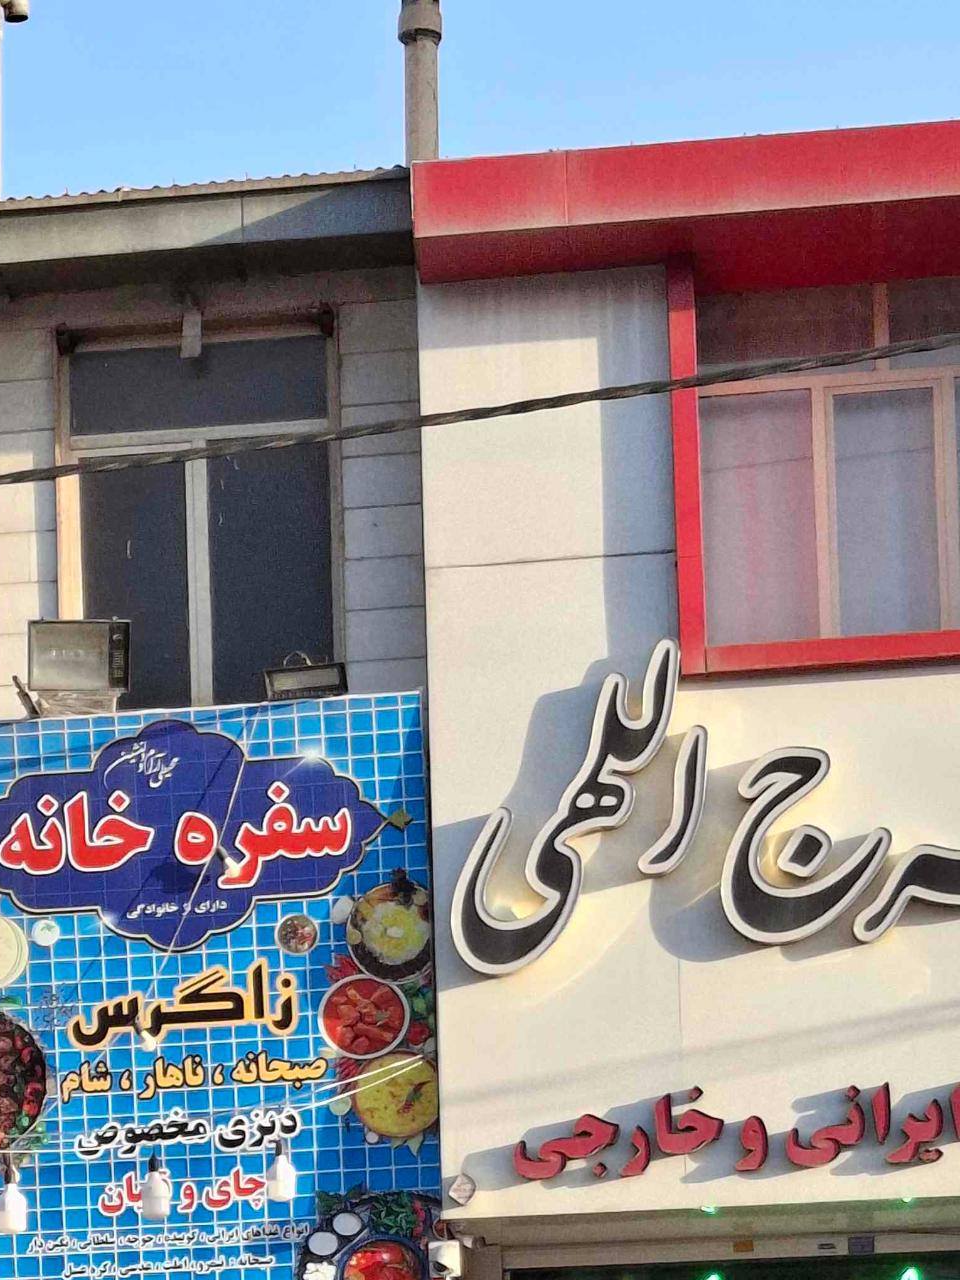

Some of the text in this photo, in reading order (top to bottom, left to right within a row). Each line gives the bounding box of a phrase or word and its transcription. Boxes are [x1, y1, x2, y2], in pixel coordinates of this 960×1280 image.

[174, 782, 352, 890] سفره
[721, 746, 960, 946] رج
[126, 902, 179, 919] خانوادگی
[194, 900, 228, 914] دارای
[67, 957, 300, 1048] زاگرس
[61, 1059, 112, 1103] شام
[137, 1055, 205, 1099] ناهار
[231, 1050, 328, 1089] صبحانه
[74, 1107, 302, 1159] دیزی مخصوص
[512, 1085, 724, 1181] خارجی
[735, 1115, 769, 1172] و
[178, 1181, 198, 1212] و
[202, 1167, 267, 1210] چای
